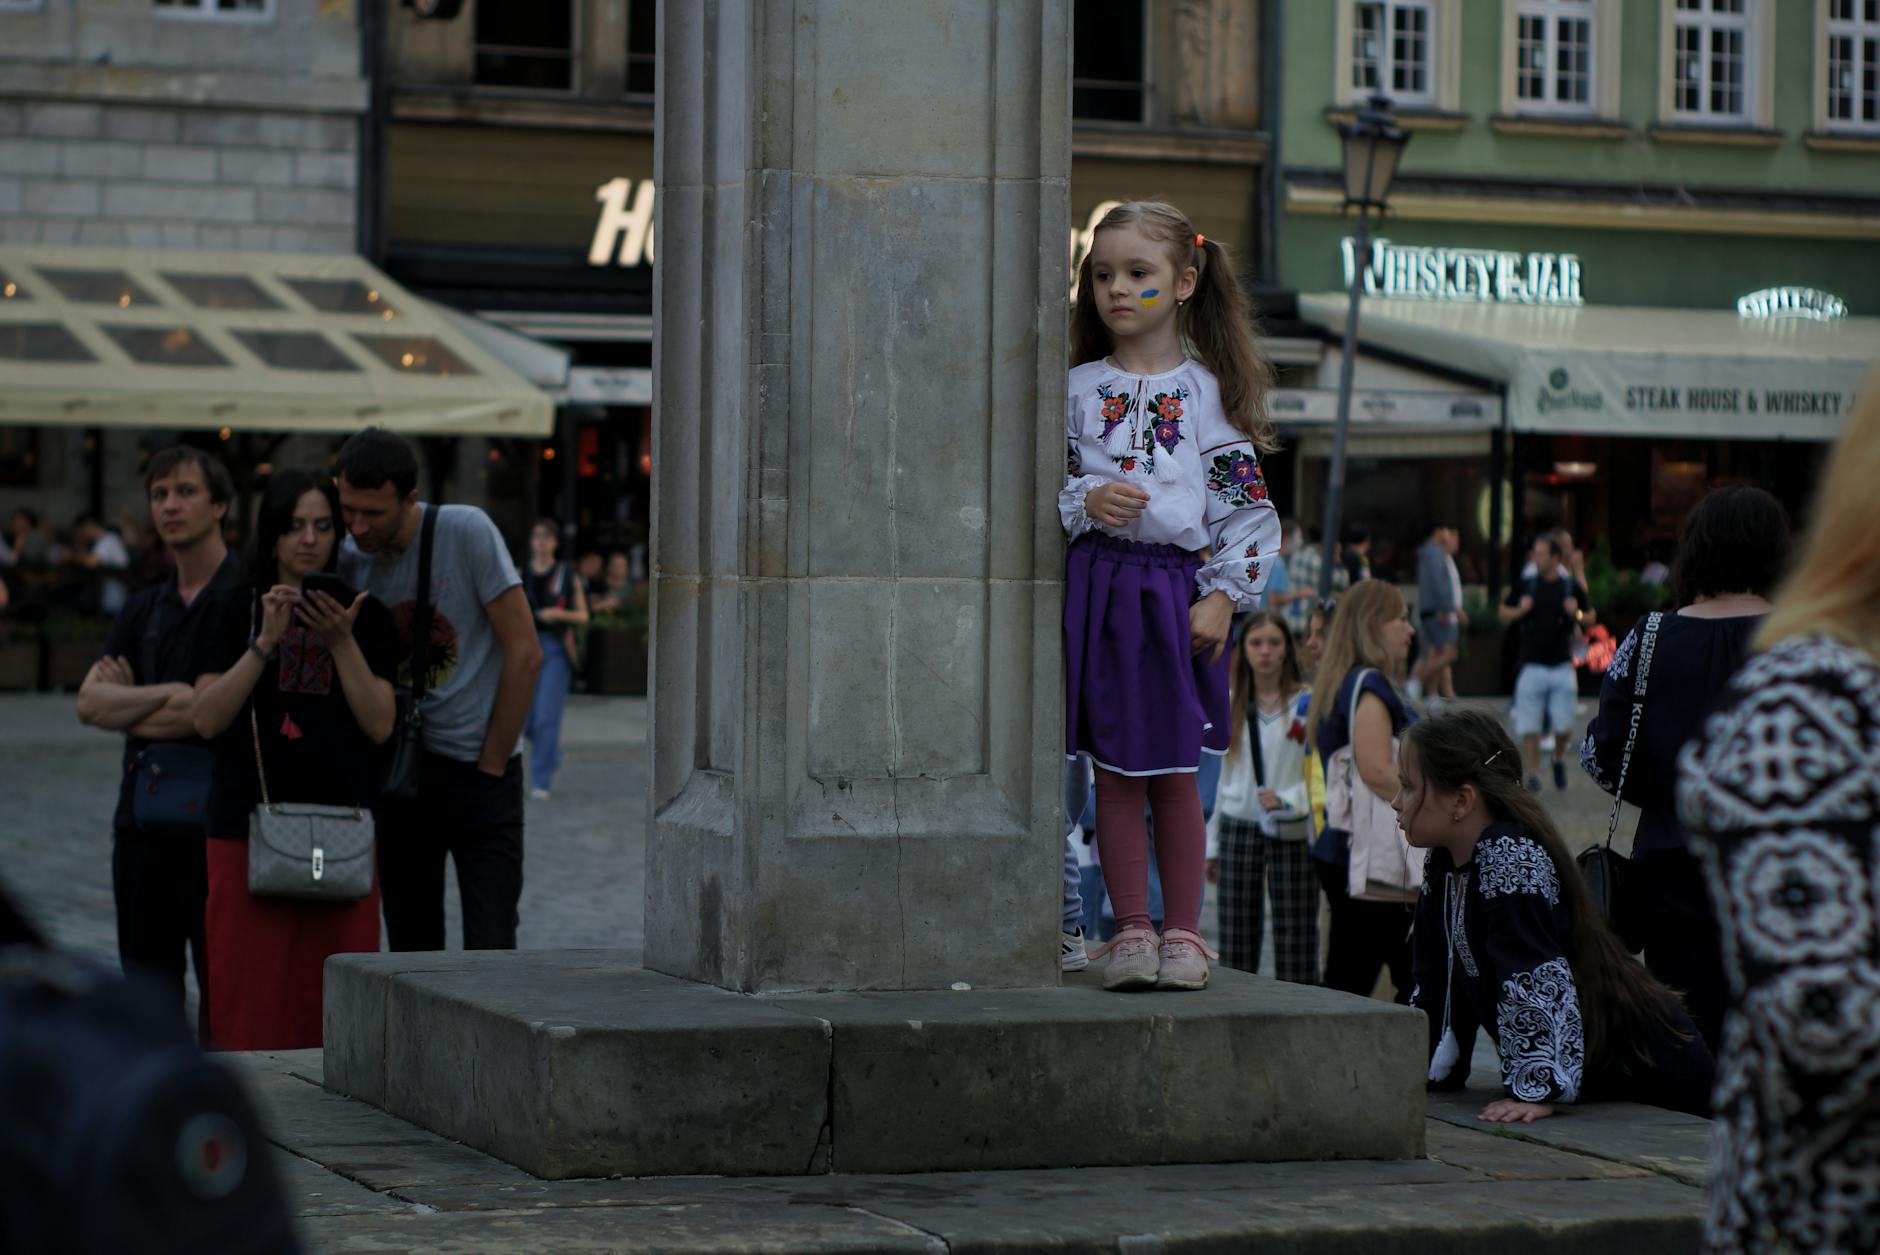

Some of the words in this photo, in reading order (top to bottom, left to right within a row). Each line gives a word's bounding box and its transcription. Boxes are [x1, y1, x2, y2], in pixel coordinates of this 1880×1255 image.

[1626, 386, 1681, 411] STEAK
[1686, 388, 1740, 413] HOUSE
[1748, 390, 1758, 413] &
[1765, 391, 1842, 416] WHISKEY
